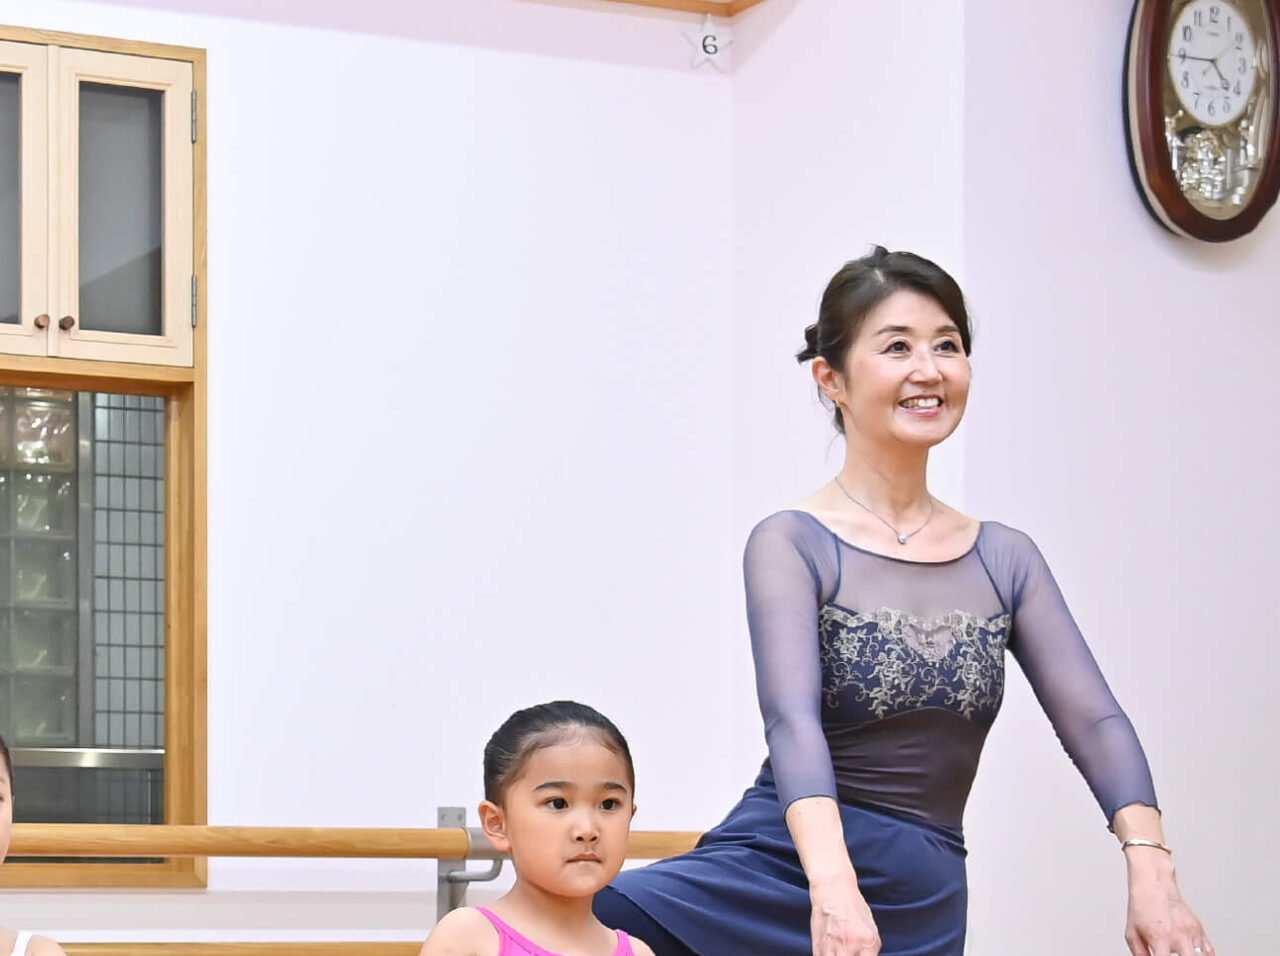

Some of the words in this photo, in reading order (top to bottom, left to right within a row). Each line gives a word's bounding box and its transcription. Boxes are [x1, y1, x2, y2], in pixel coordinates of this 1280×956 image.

[1193, 10, 1202, 27] 11
[1209, 6, 1219, 24] 12
[1182, 25, 1192, 41] 10
[1234, 32, 1243, 50] 2
[702, 35, 718, 55] 6
[1238, 57, 1247, 75] 3
[1180, 71, 1189, 89] 8
[1233, 80, 1241, 96] 4
[1193, 91, 1200, 111] 7
[1207, 100, 1216, 117] 6
